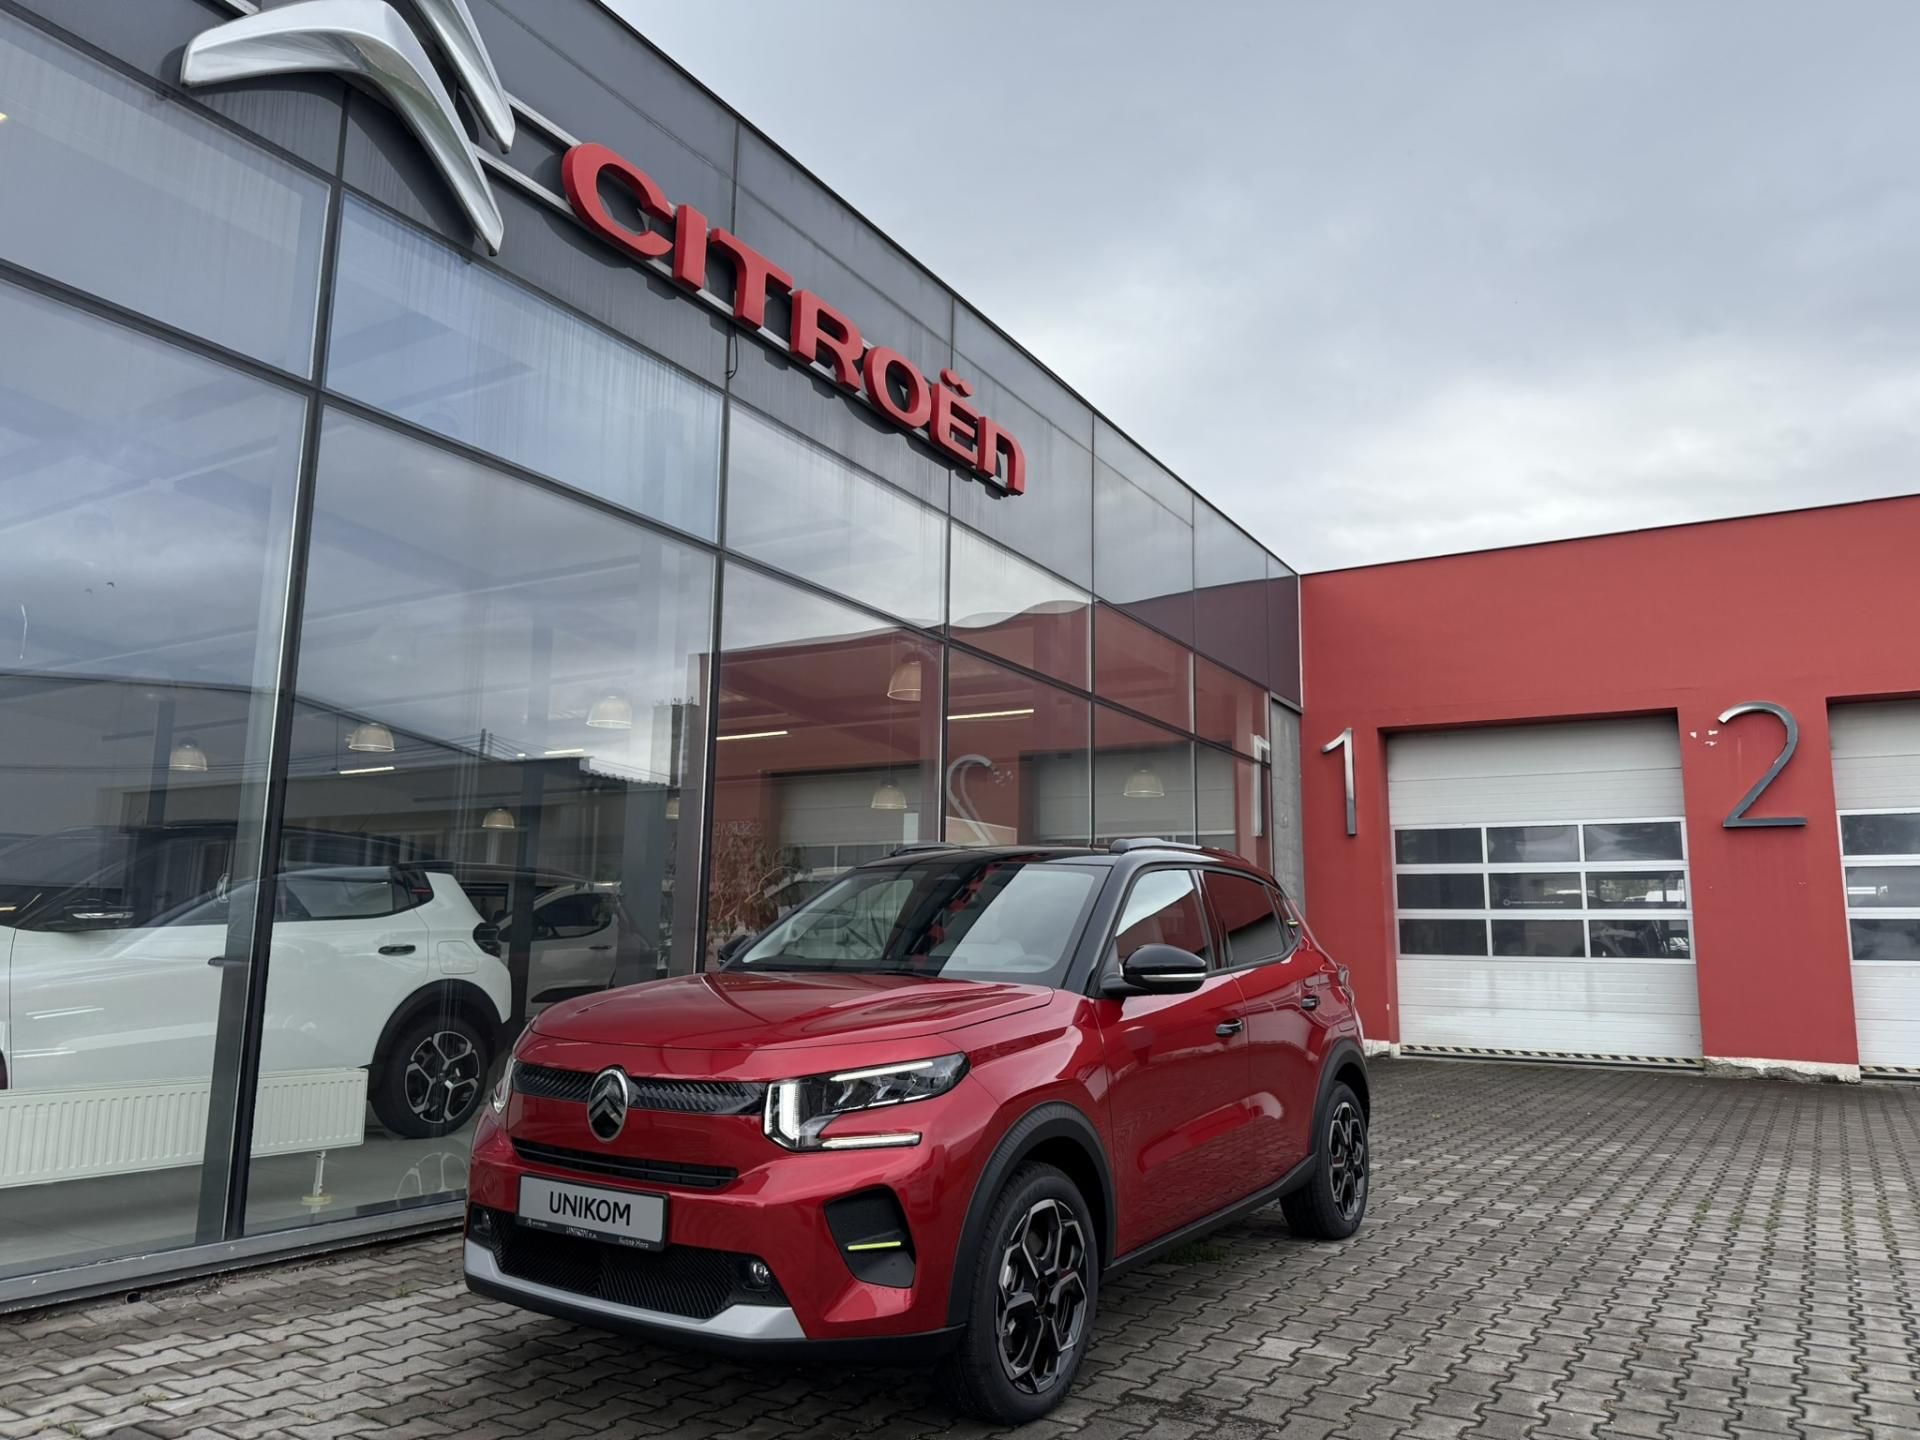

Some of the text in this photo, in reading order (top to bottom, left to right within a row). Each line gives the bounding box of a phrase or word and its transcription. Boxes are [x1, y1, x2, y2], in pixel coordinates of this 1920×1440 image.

[562, 143, 1025, 495] CITROËN
[1321, 727, 1356, 836] 1
[1718, 701, 1808, 828] 2
[549, 1191, 631, 1227] UNIKOM
